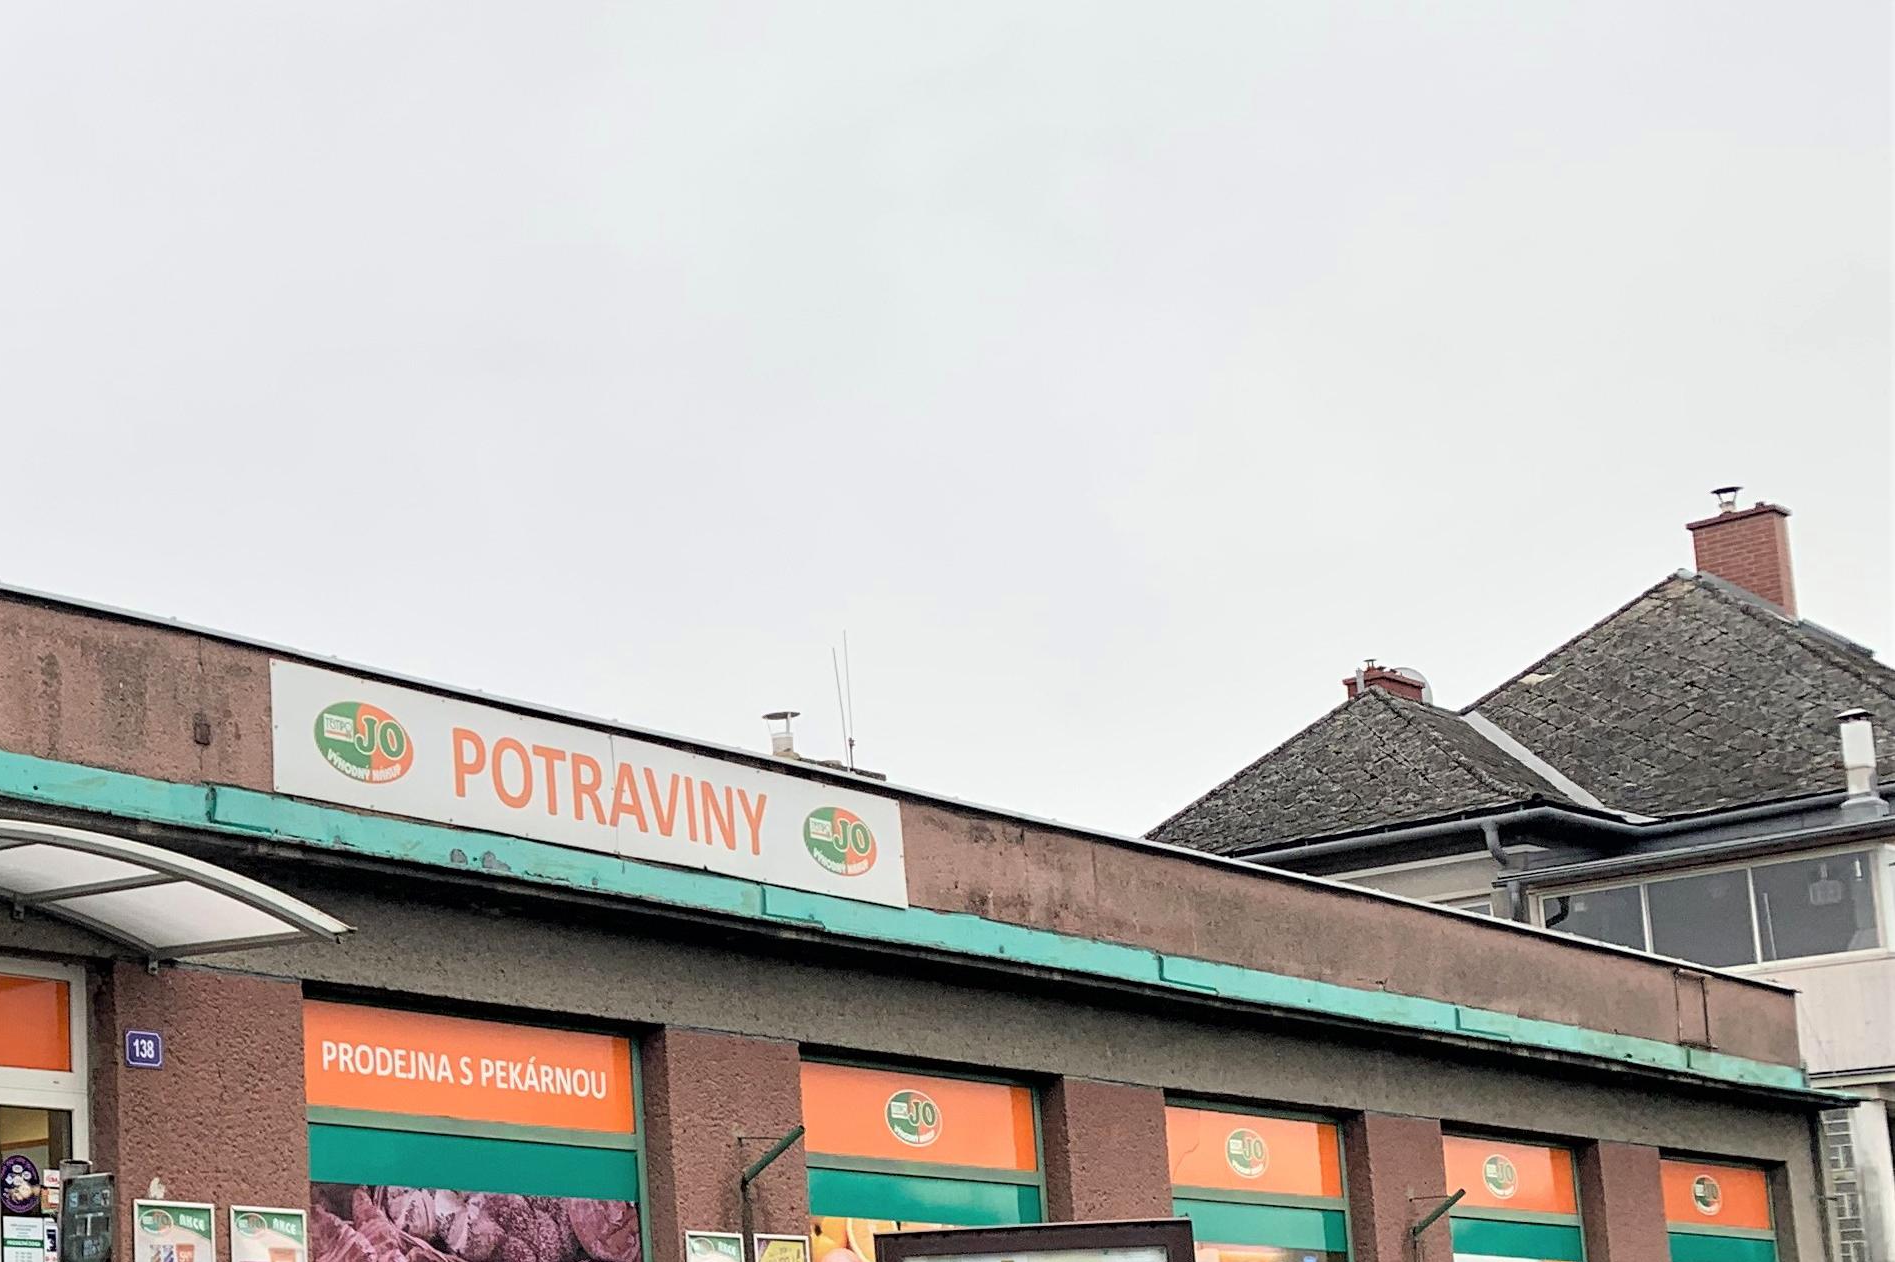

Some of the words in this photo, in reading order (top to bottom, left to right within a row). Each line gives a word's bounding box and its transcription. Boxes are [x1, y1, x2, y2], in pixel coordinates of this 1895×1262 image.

[354, 715, 406, 760] JO
[451, 726, 767, 856] POTRAVINY
[833, 817, 871, 856] JO
[133, 1038, 155, 1059] 138
[321, 1040, 455, 1084] PRODEJNA
[459, 1056, 474, 1086] S
[480, 1056, 607, 1100] PEKÁRNOU
[908, 1100, 936, 1127] JO
[1242, 1136, 1265, 1161] JO
[1497, 1161, 1516, 1184] JO
[179, 1213, 205, 1232] AKCE
[272, 1217, 297, 1235] AKCE
